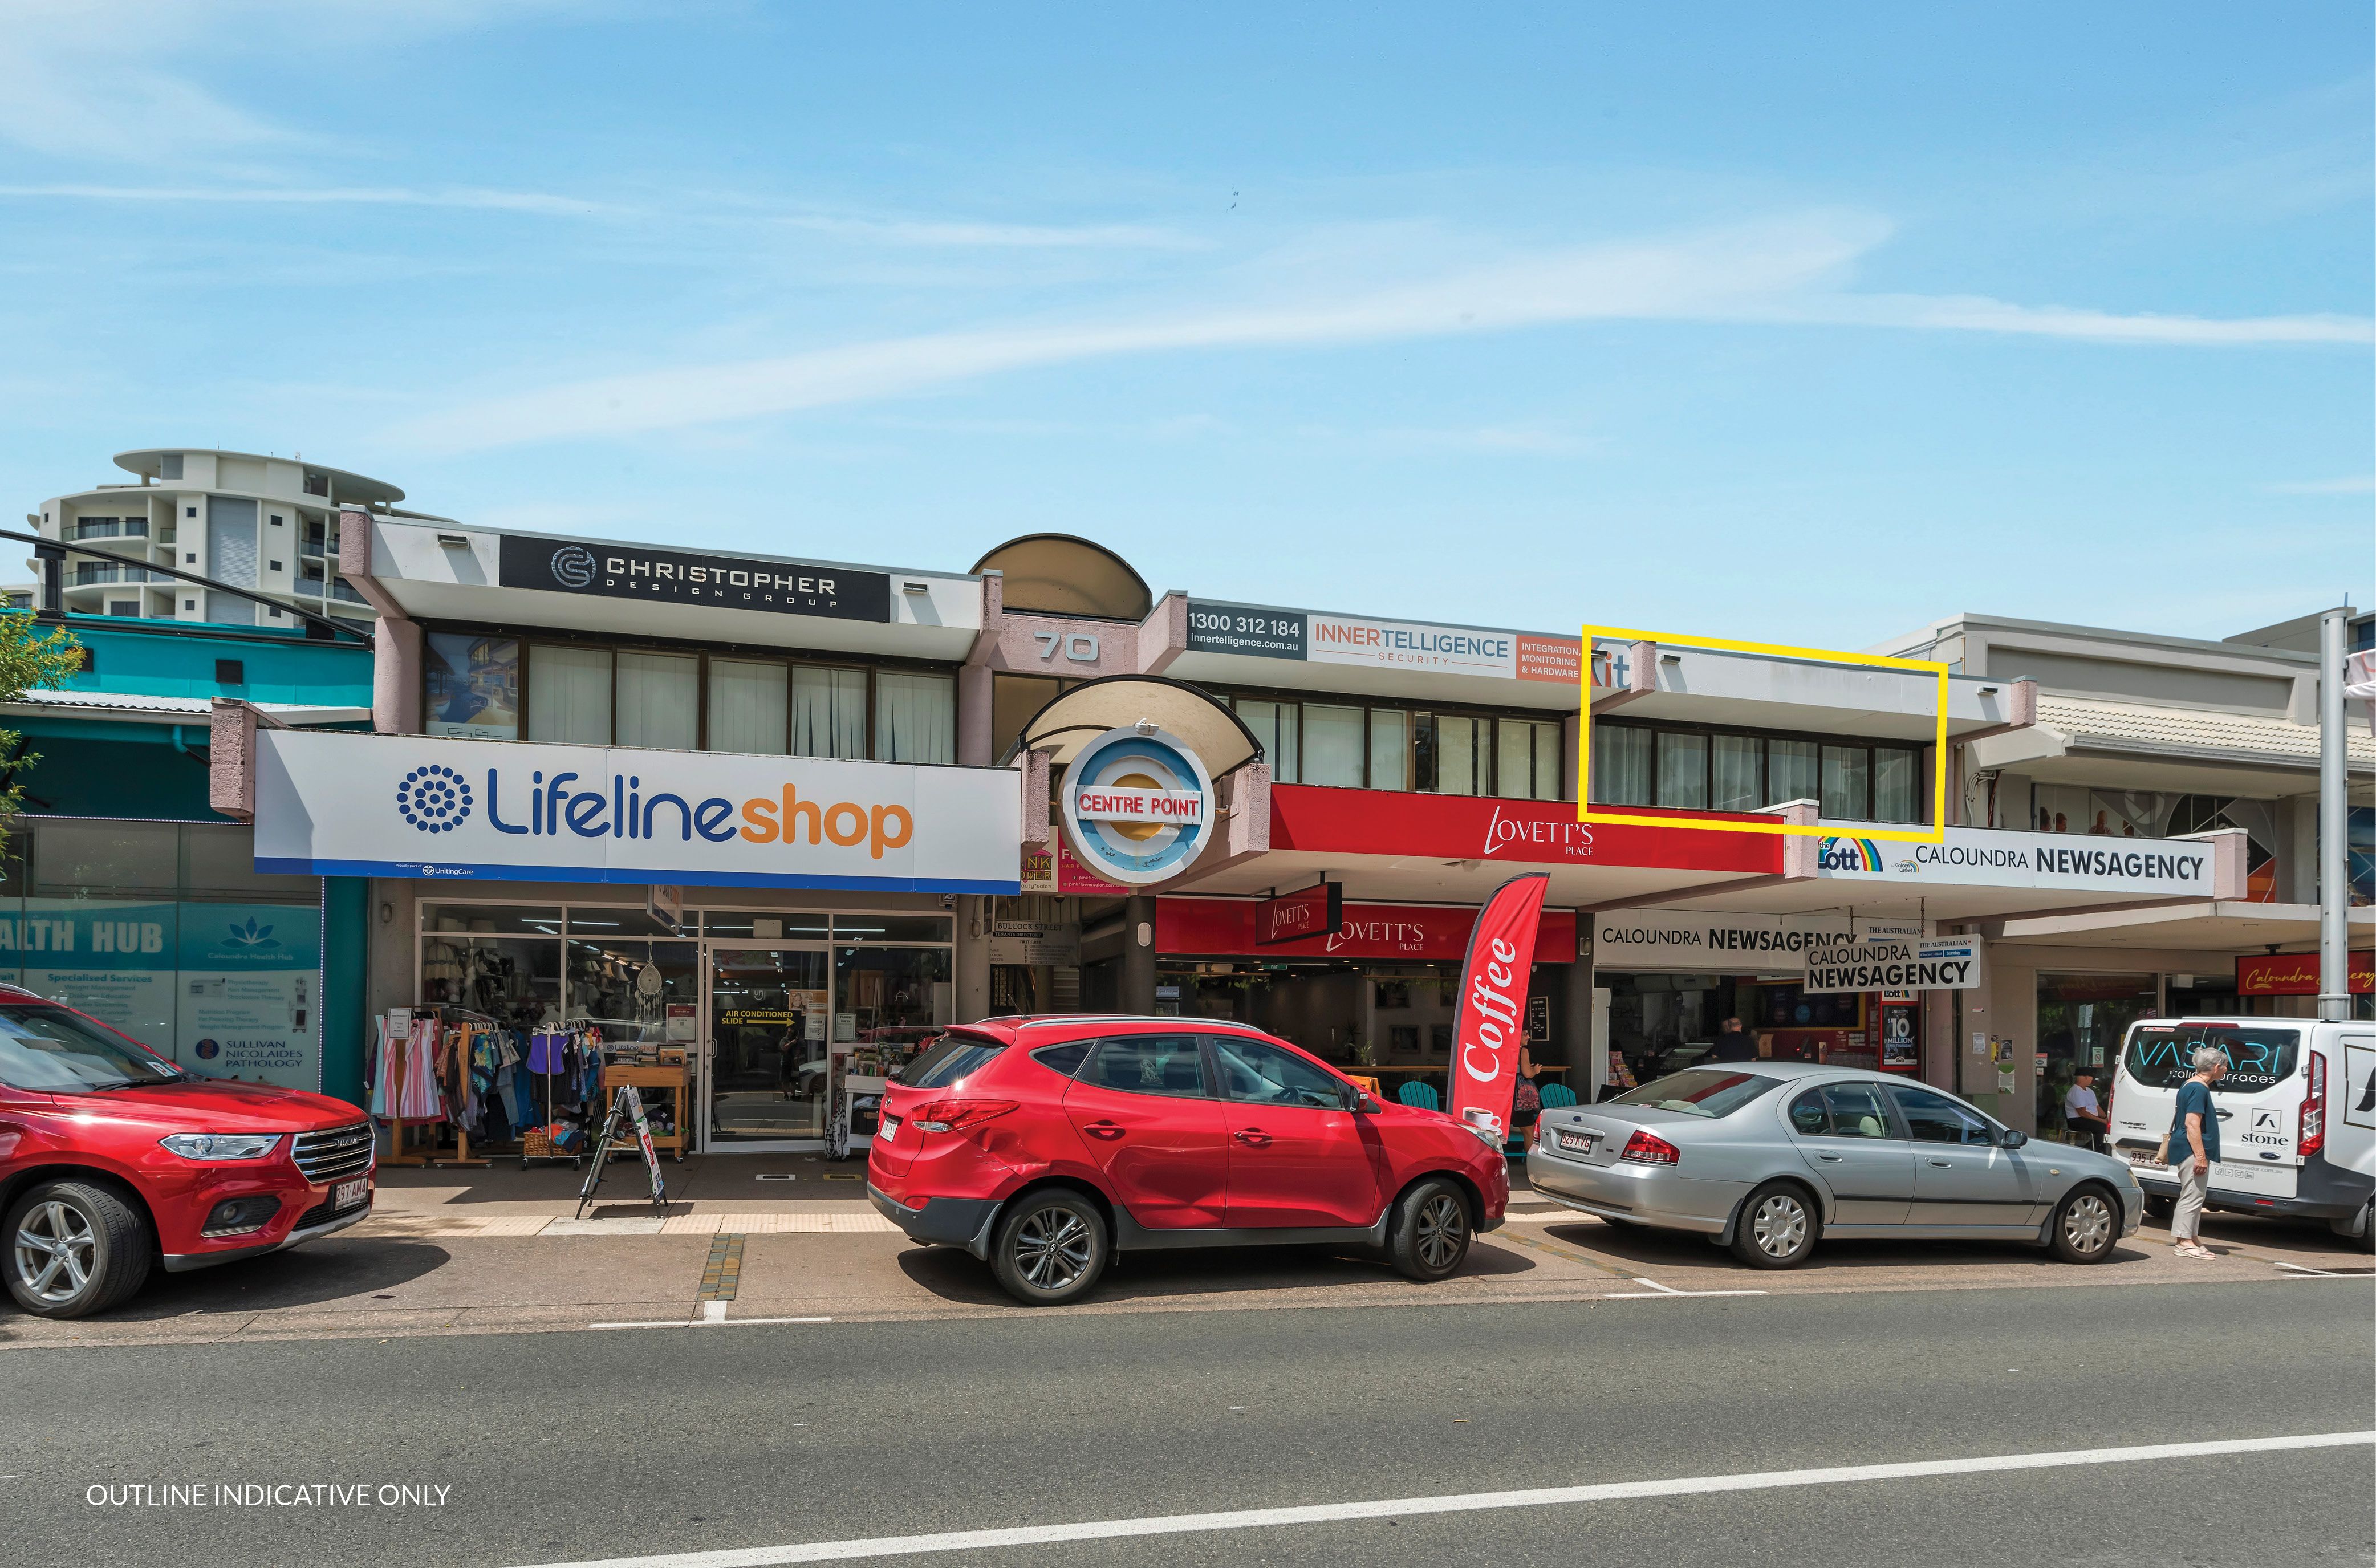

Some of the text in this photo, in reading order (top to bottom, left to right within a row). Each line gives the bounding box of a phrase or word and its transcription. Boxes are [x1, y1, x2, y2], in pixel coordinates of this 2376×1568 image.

[606, 557, 836, 595] CHRISTOPHER
[606, 579, 838, 608] DESIGN GROUP
[1189, 612, 1300, 637] 1300 312 184
[1034, 629, 1099, 662] 70
[1191, 633, 1298, 651] innertelligence.com.au
[1315, 623, 1508, 659] INNERTELLIGENCE
[1521, 643, 1581, 657] INTEGRATION,
[1379, 652, 1449, 666] SECURITY
[1522, 654, 1577, 667] MONITORING
[1521, 665, 1579, 678] & HARDWARE
[1079, 793, 1199, 817] CENTRE POINT
[1484, 805, 1594, 855] LOVETT'S
[1565, 845, 1594, 856] PLACE
[1915, 845, 2204, 881] CALOUNDRA NEWSAGENCY
[1021, 871, 1051, 880] OWER
[1298, 921, 1309, 930] PLACE
[92, 921, 163, 953] HUB
[1602, 927, 1702, 945] CALOUNDRA
[1399, 943, 1424, 951] PLACE
[1809, 944, 1911, 966] CALOUNDRA
[48, 973, 152, 983] Specialised Services
[1809, 961, 1971, 989] NEWSAGENCY
[2246, 966, 2316, 989] Caloundra
[1463, 937, 1517, 1082] Coffee
[2219, 1071, 2276, 1084] urfaces
[2240, 1143, 2288, 1151] AMBASSADOR
[2241, 1132, 2289, 1146] stone
